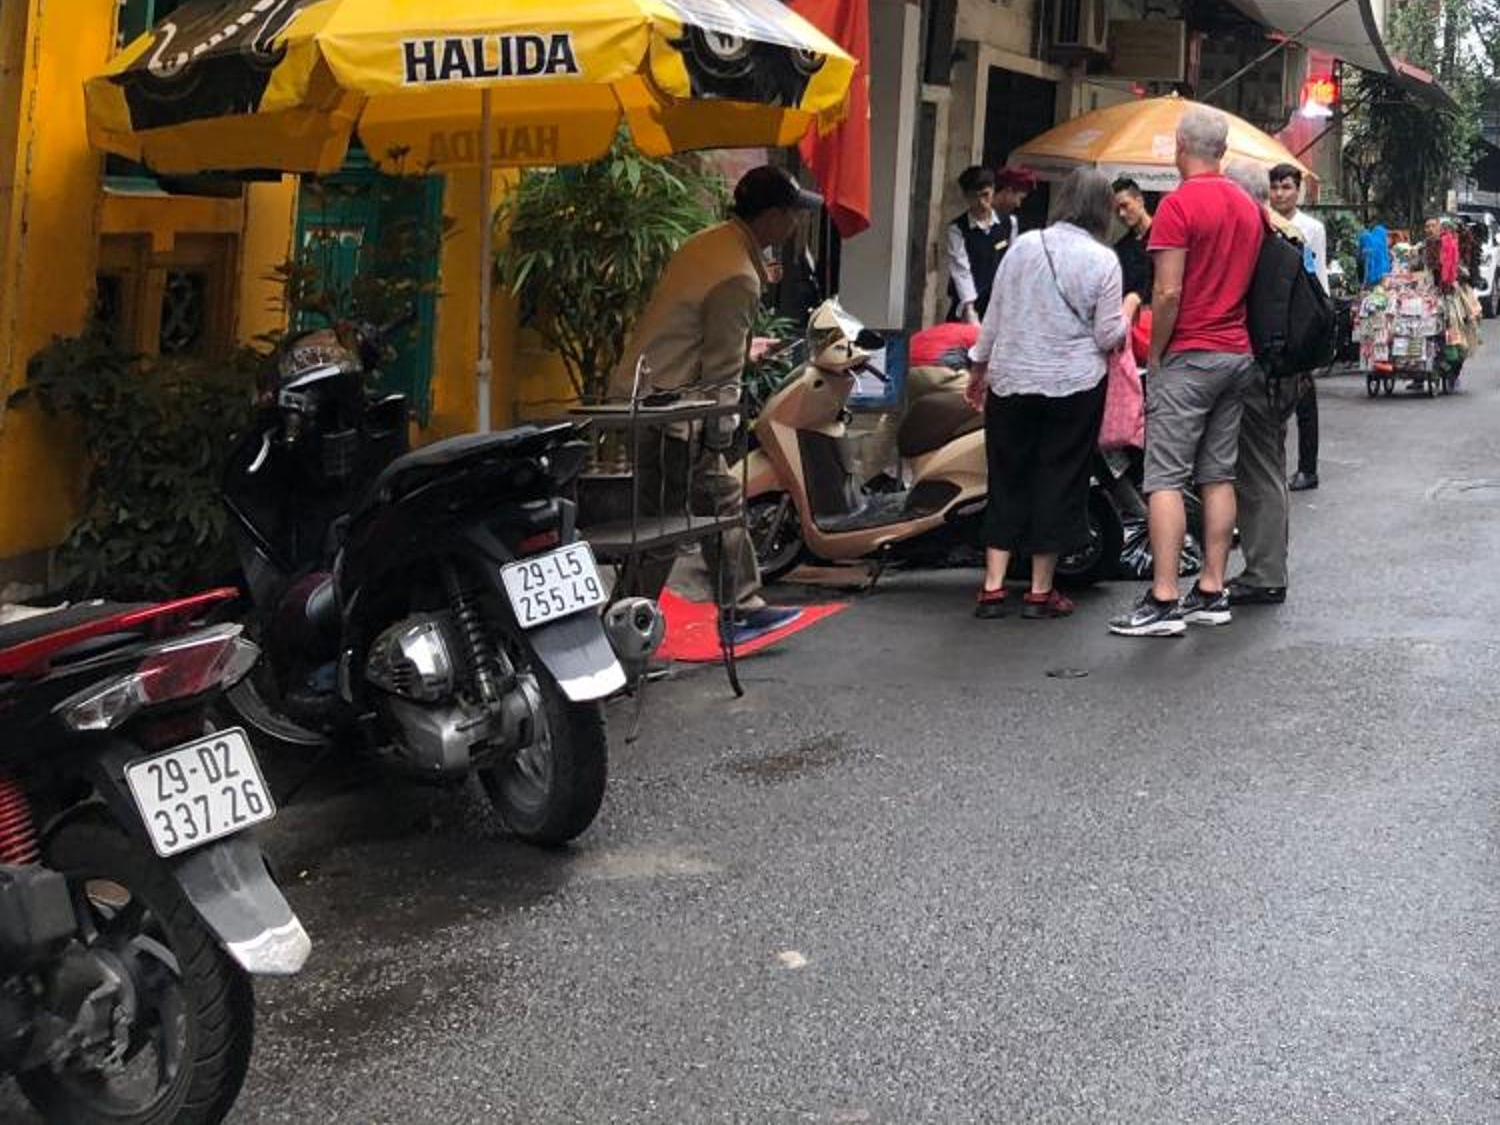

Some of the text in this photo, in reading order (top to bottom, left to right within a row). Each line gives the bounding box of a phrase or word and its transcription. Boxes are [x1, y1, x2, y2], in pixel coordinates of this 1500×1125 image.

[403, 33, 580, 83] HALIDA
[517, 551, 583, 592] 29-L5
[519, 576, 601, 622] 255.49
[147, 740, 240, 802] 29-D2
[154, 779, 263, 847] 337.26
